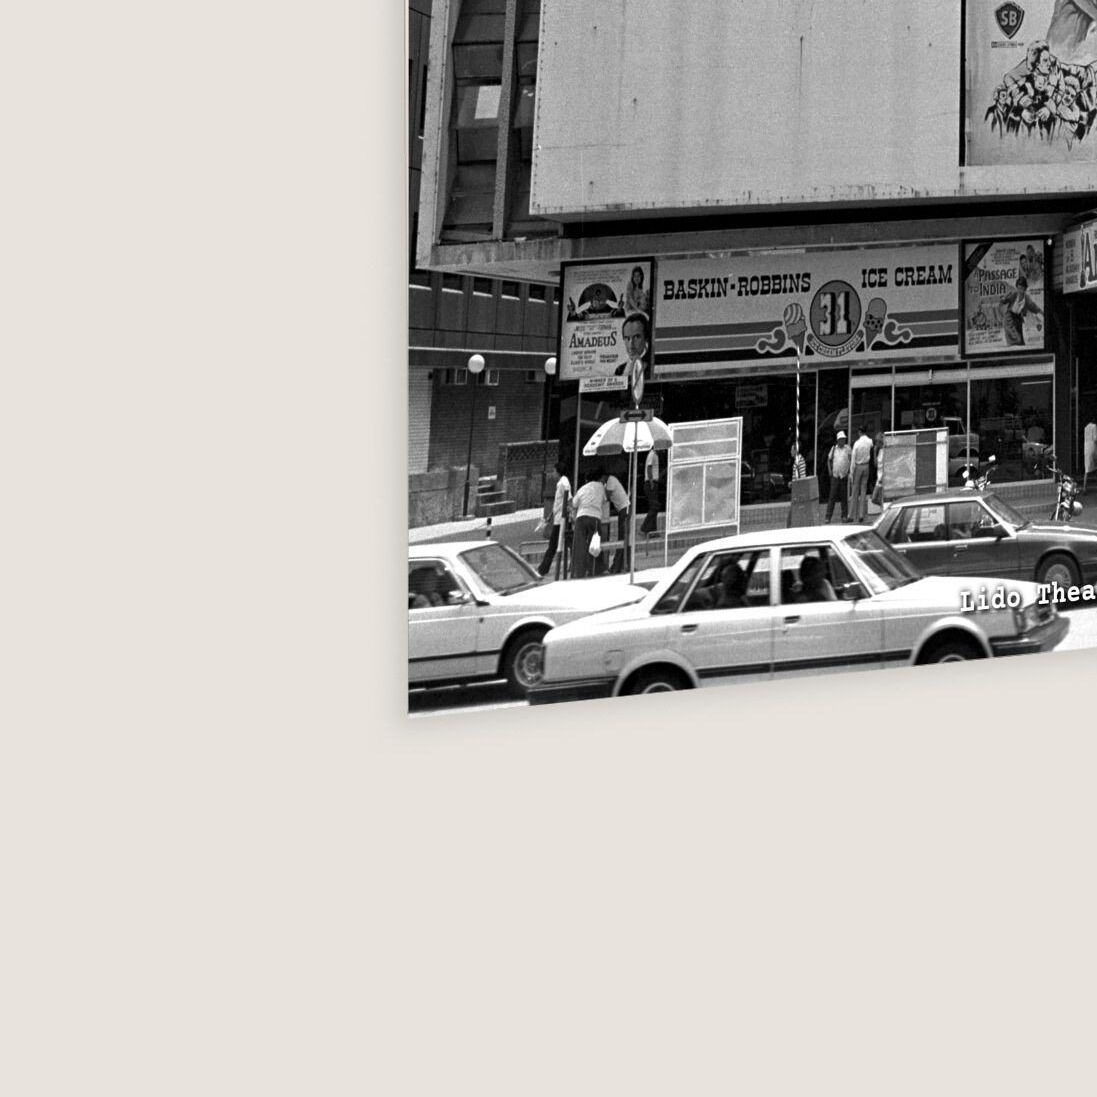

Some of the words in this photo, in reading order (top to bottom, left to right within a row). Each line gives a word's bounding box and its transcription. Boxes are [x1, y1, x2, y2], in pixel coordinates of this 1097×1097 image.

[1000, 10, 1017, 26] SB
[862, 268, 887, 288] ICE
[894, 264, 953, 287] CREAM
[978, 268, 1017, 282] PASSAGE
[663, 272, 811, 300] BASKIN-ROBBINS
[980, 283, 1006, 296] INDIA
[819, 291, 852, 336] 31
[569, 331, 617, 348] AMADEUS
